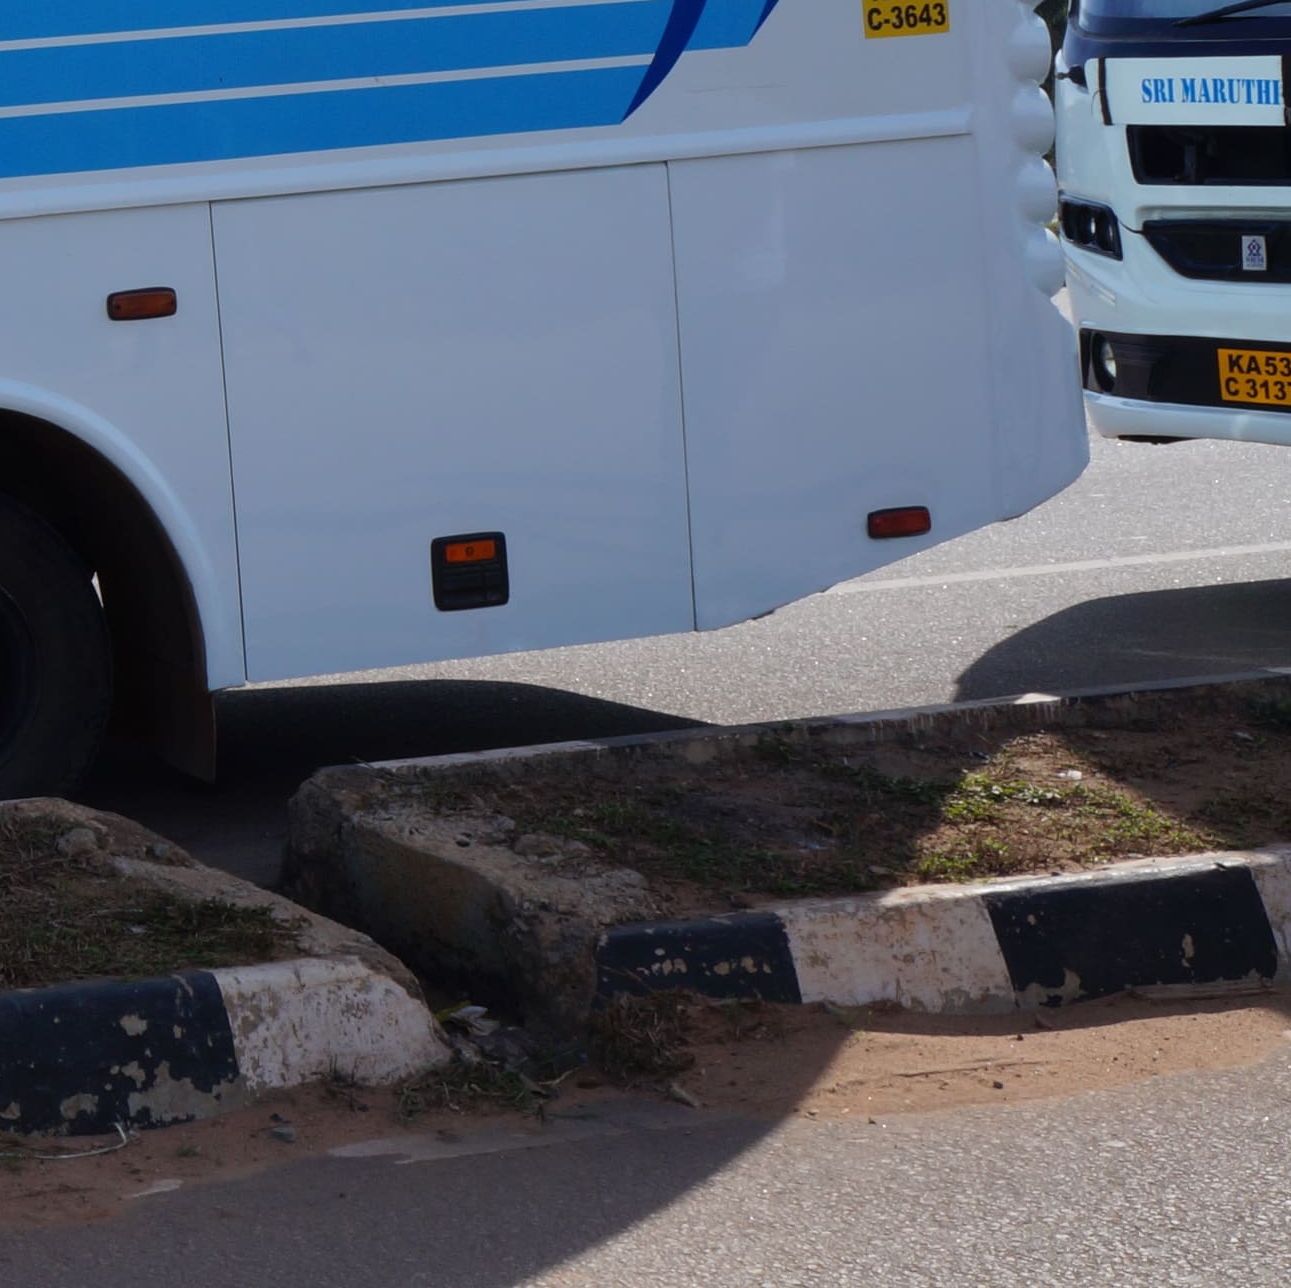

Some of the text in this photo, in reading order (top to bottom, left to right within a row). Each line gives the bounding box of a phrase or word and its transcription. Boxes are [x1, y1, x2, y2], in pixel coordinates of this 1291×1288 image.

[867, 3, 946, 31] C-3643
[1141, 78, 1280, 105] SRI MARUTHI
